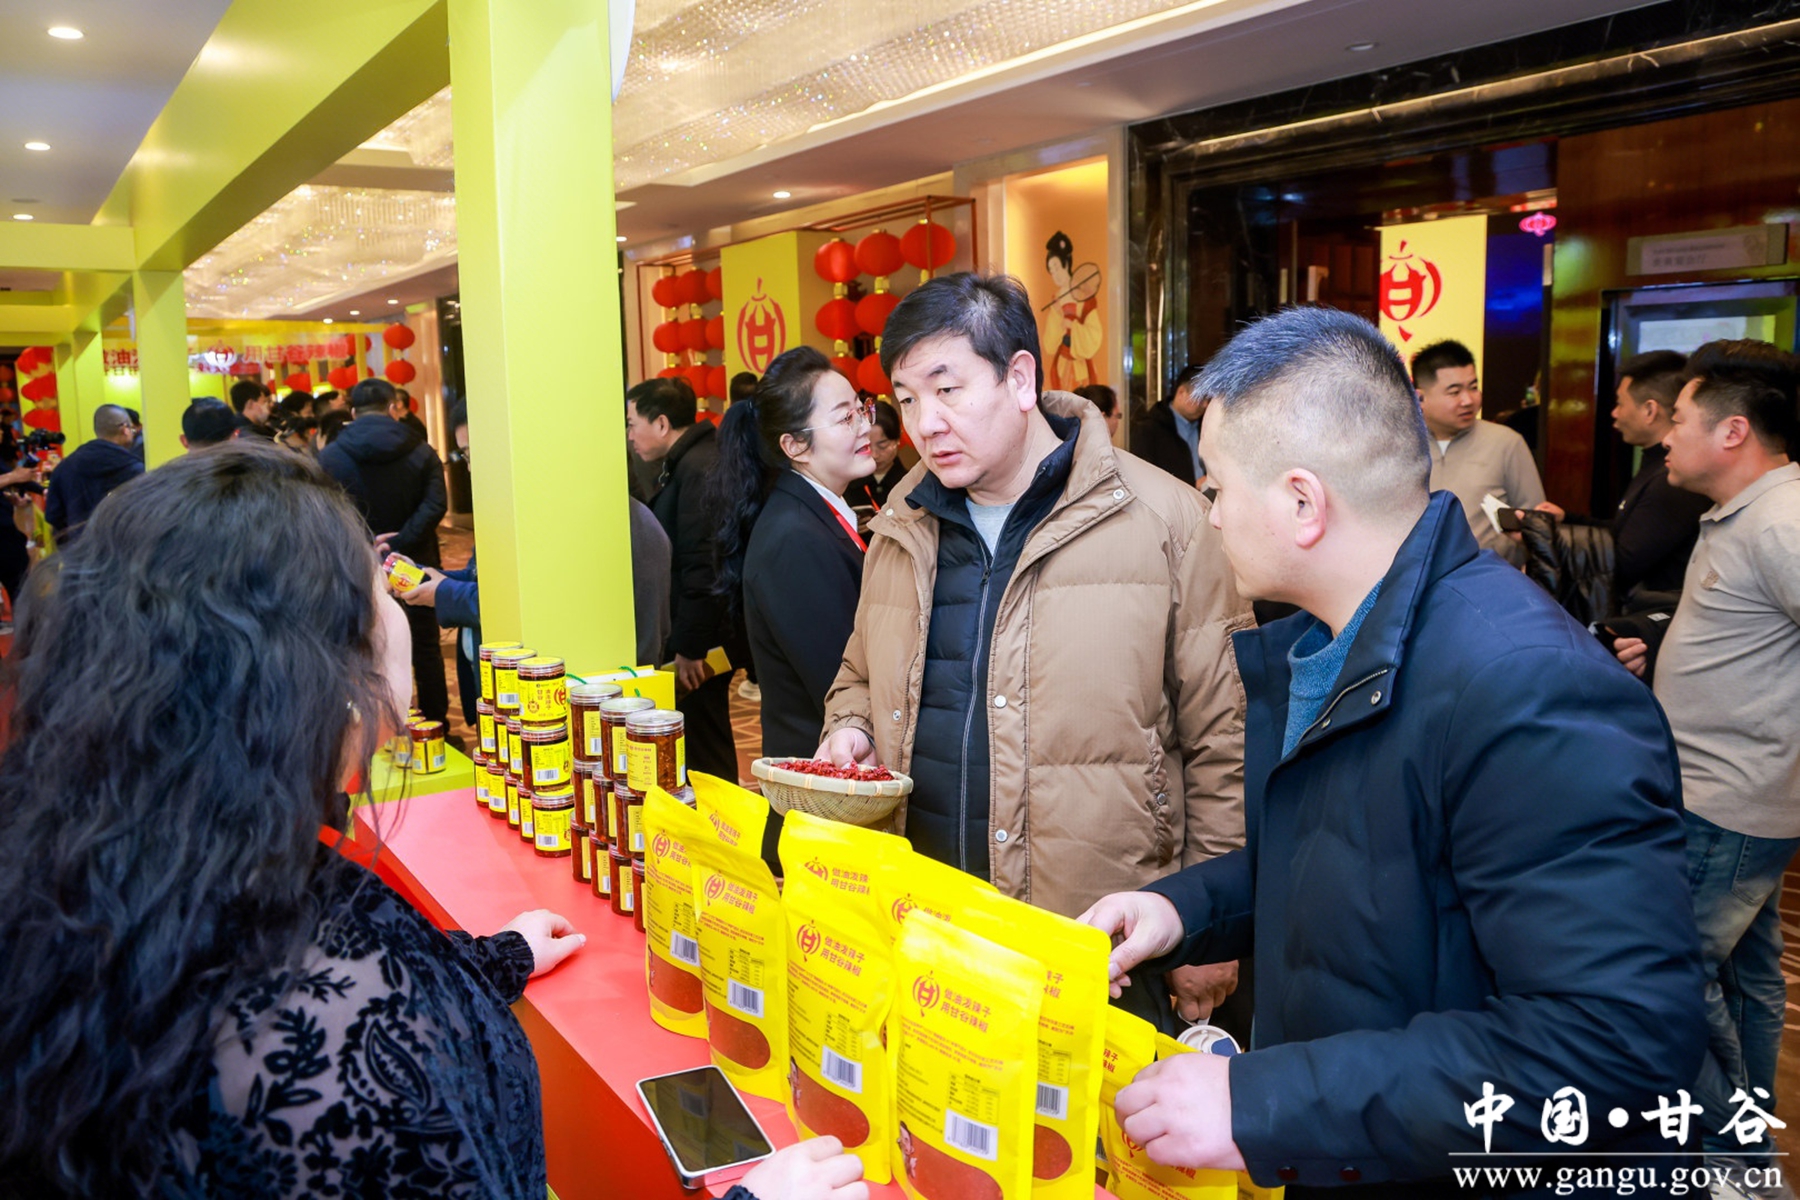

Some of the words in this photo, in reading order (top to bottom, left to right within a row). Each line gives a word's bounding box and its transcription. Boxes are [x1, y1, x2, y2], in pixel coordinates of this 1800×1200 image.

[672, 841, 686, 853] 做油
[832, 868, 869, 882] 做油泼辣
[941, 1002, 988, 1032] 用甘谷辣椒
[1172, 1163, 1198, 1180] 辣椒
